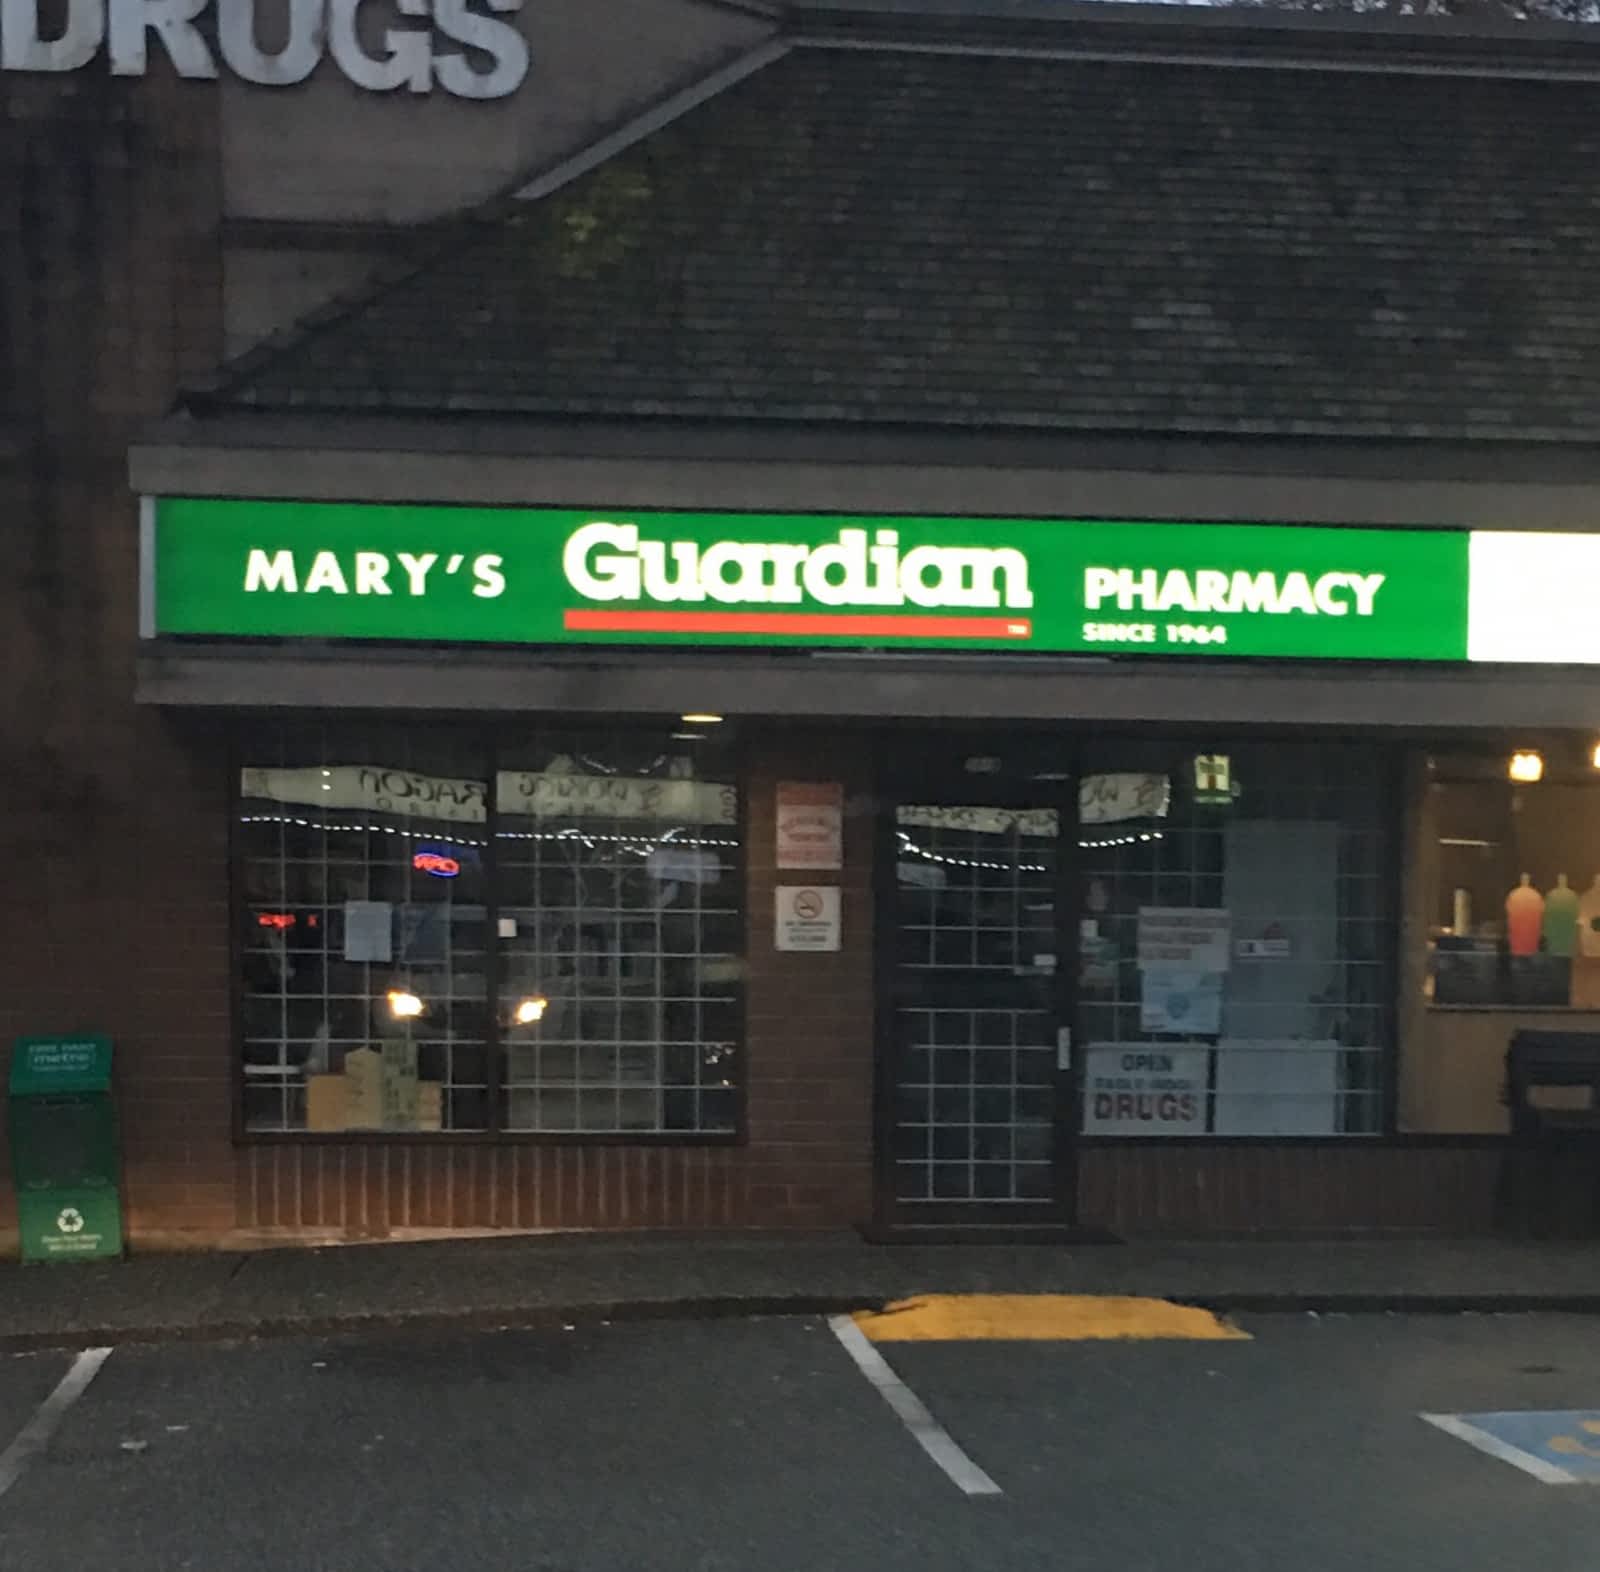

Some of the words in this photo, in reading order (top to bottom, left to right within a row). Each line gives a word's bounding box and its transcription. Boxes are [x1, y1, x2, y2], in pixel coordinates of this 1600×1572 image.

[0, 0, 528, 98] DRUGS
[244, 549, 505, 598] MARY'S
[563, 522, 1034, 608] Guardian
[1084, 567, 1386, 616] PHARMACY
[1083, 622, 1156, 642] SINCE
[1166, 624, 1227, 644] 1964
[1121, 1053, 1173, 1072] OPEN
[1095, 1093, 1198, 1121] DRUGS
